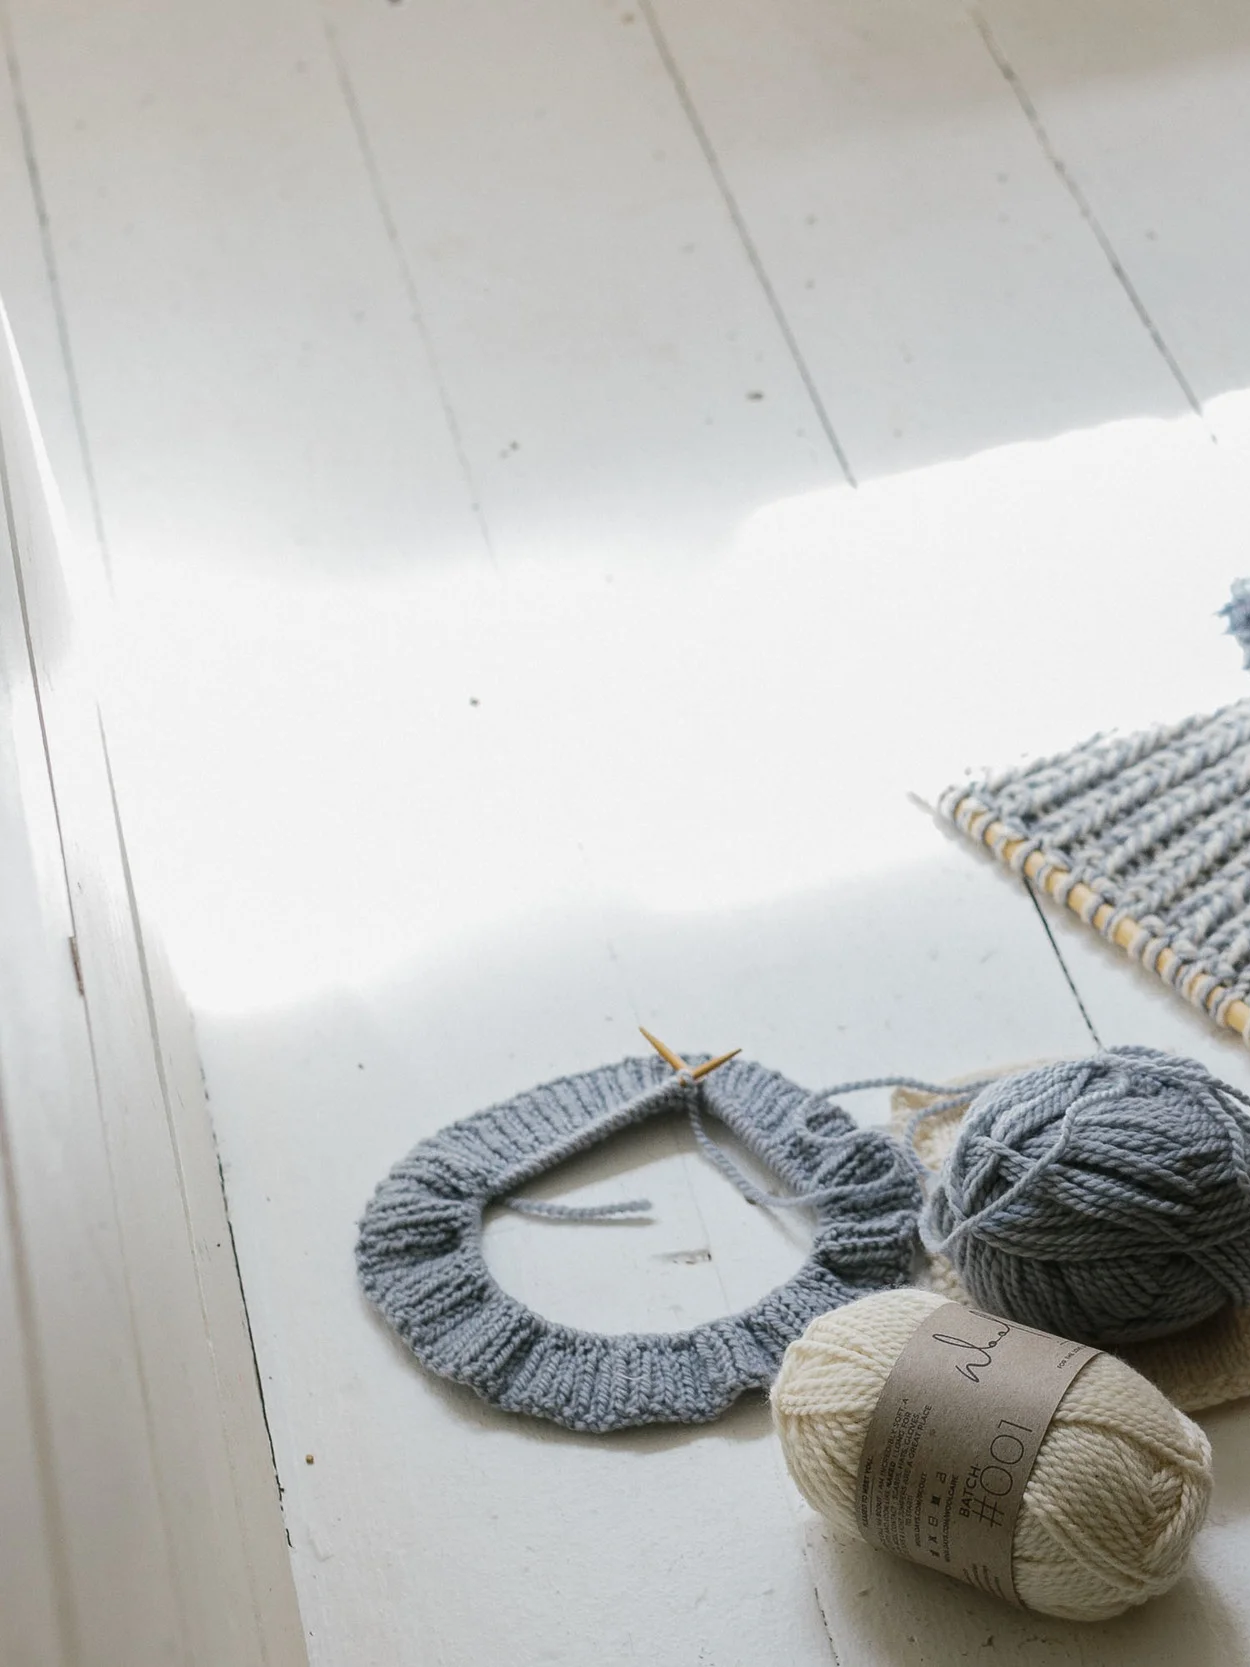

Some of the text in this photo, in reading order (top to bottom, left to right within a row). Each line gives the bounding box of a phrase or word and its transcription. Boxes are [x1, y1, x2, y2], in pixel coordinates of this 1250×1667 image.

[901, 1397, 908, 1405] A
[893, 1430, 905, 1452] LONG
[900, 1411, 911, 1428] FOR
[907, 1431, 921, 1459] GREAT
[917, 1404, 931, 1431] PLACE
[959, 1464, 981, 1518] BATCH
[972, 1420, 1033, 1528] #001
[861, 1494, 867, 1503] TO
